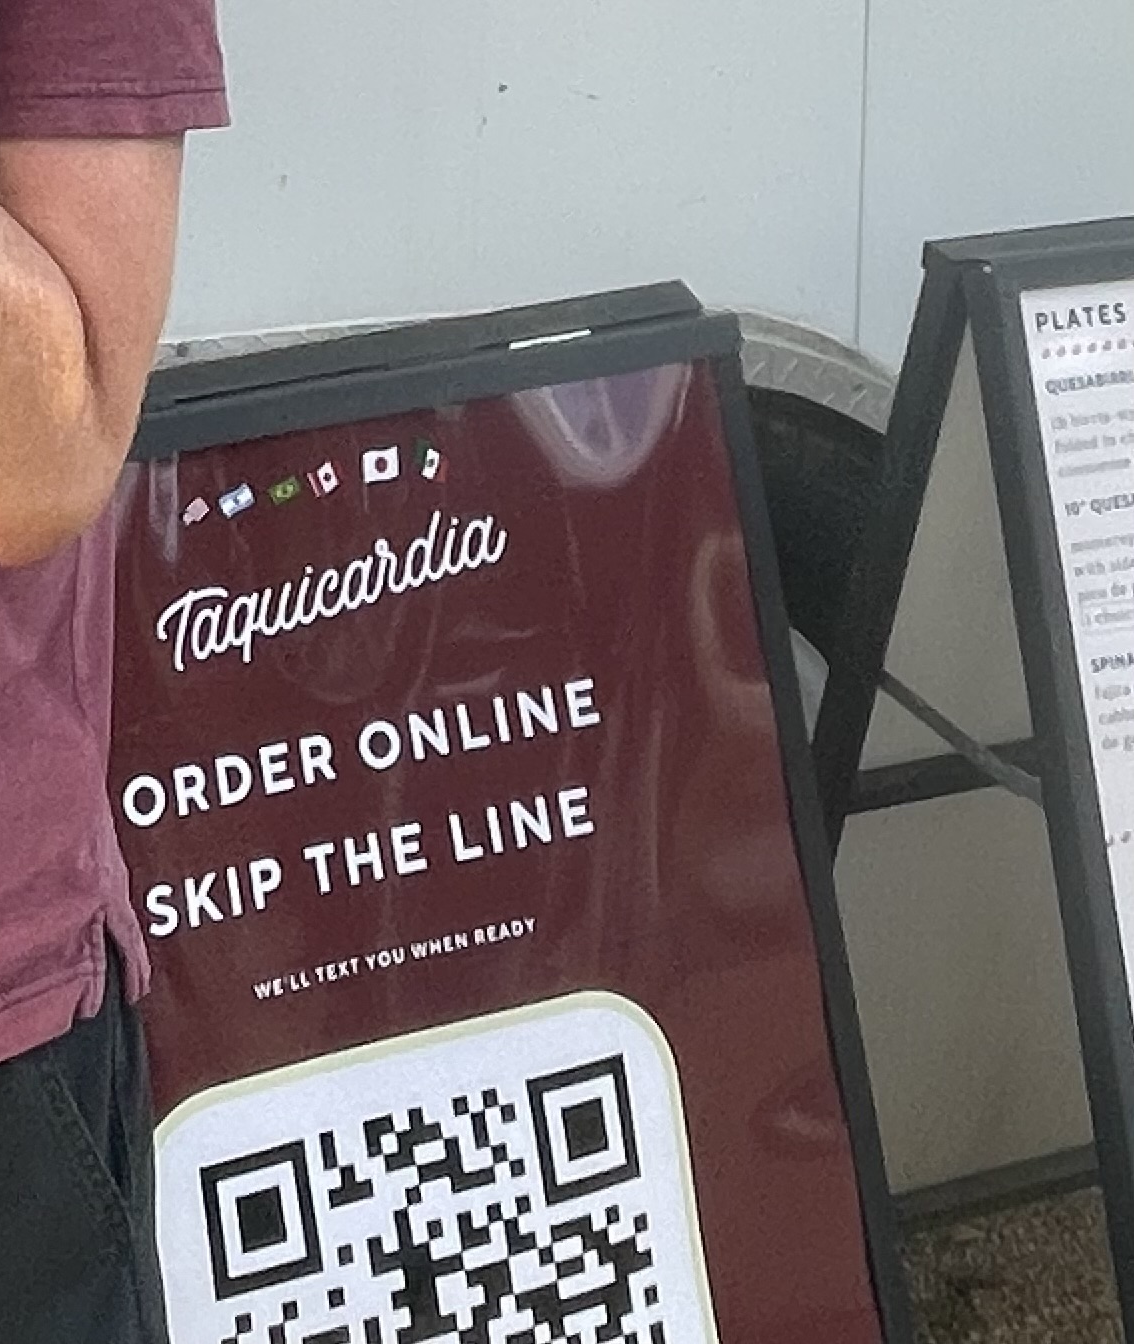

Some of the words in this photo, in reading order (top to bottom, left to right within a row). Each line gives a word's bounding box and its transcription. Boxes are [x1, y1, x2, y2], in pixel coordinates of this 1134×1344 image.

[1035, 302, 1127, 333] PLATES
[156, 510, 508, 672] Taquicardia
[122, 734, 337, 827] ORDER
[358, 678, 601, 770] ONLINE
[146, 858, 283, 937] SKIP
[303, 822, 428, 894] THE
[448, 786, 595, 862] LINE
[253, 971, 311, 1000] WE'LL
[314, 957, 359, 983] TEXT
[364, 946, 406, 971] YOU
[410, 931, 469, 960] WHEN
[473, 917, 536, 946] READY
